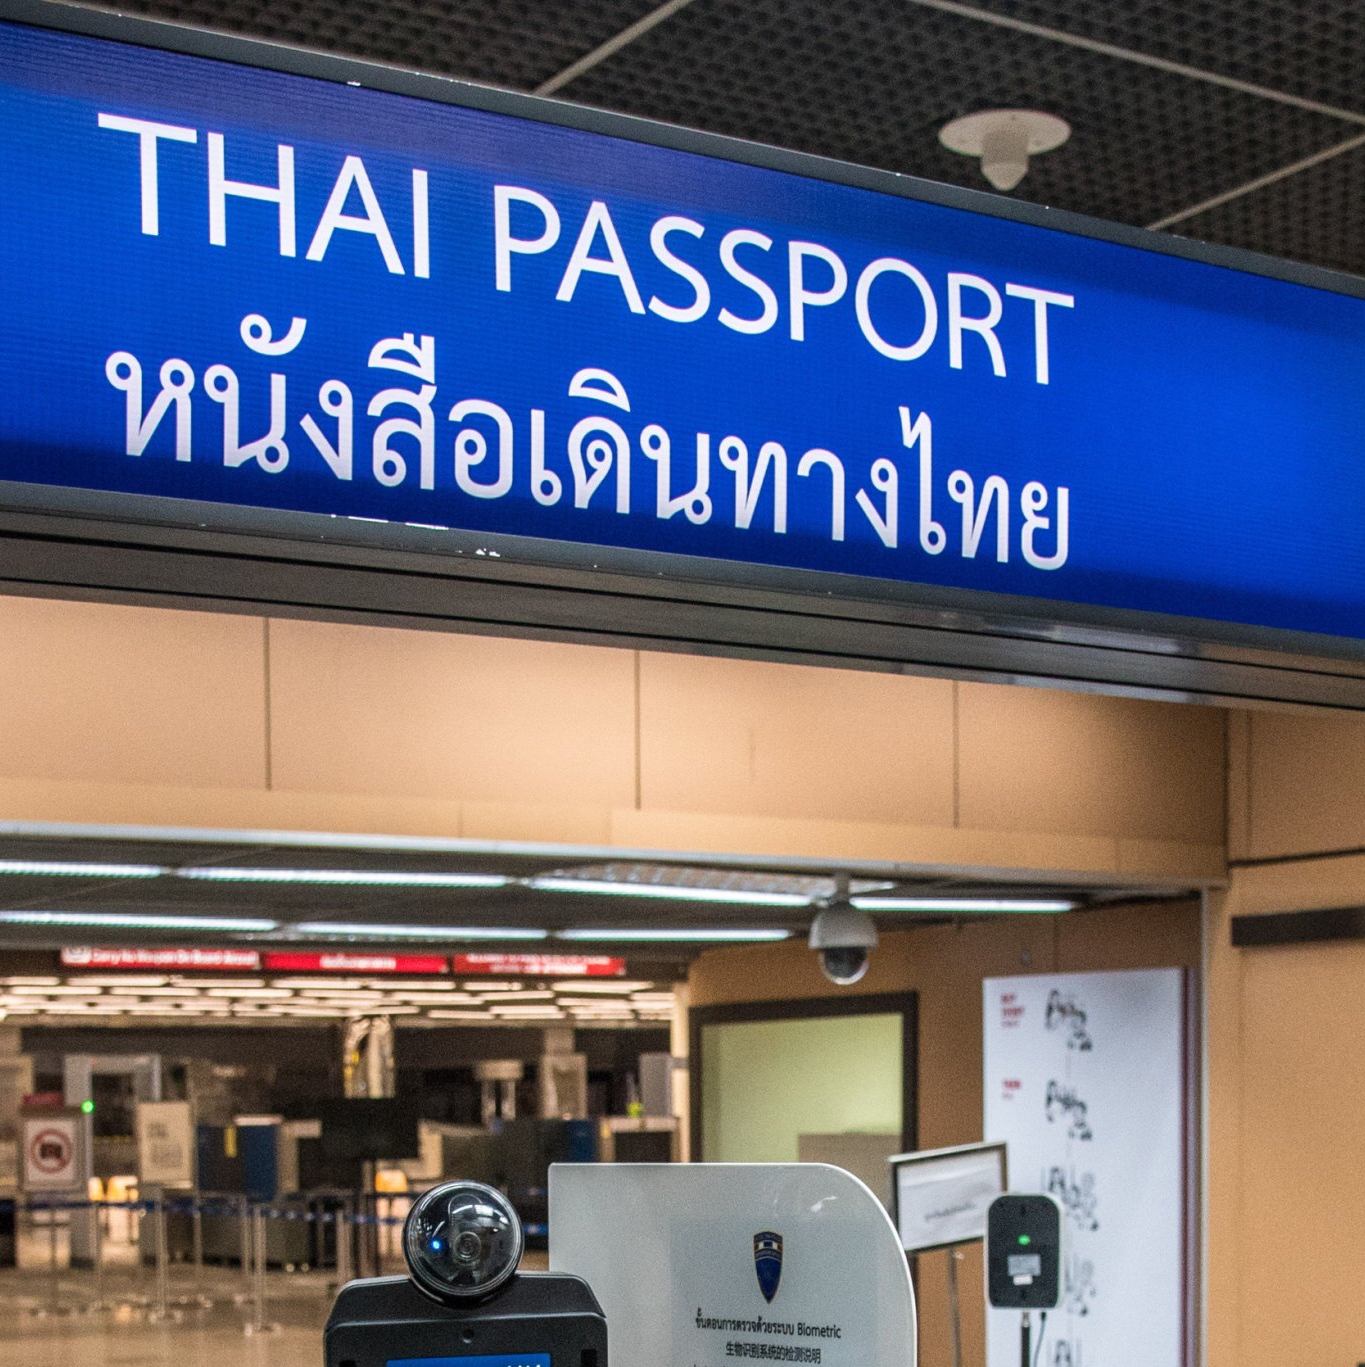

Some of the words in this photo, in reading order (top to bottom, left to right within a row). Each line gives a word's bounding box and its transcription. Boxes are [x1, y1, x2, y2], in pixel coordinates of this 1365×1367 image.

[98, 112, 430, 280] THAI
[494, 185, 1075, 386] PASSPORT
[103, 313, 1070, 572] หนังสือเดินทางไทย
[726, 1341, 822, 1365] 生物识别系统的检测说明
[797, 1322, 841, 1339] Biometric
